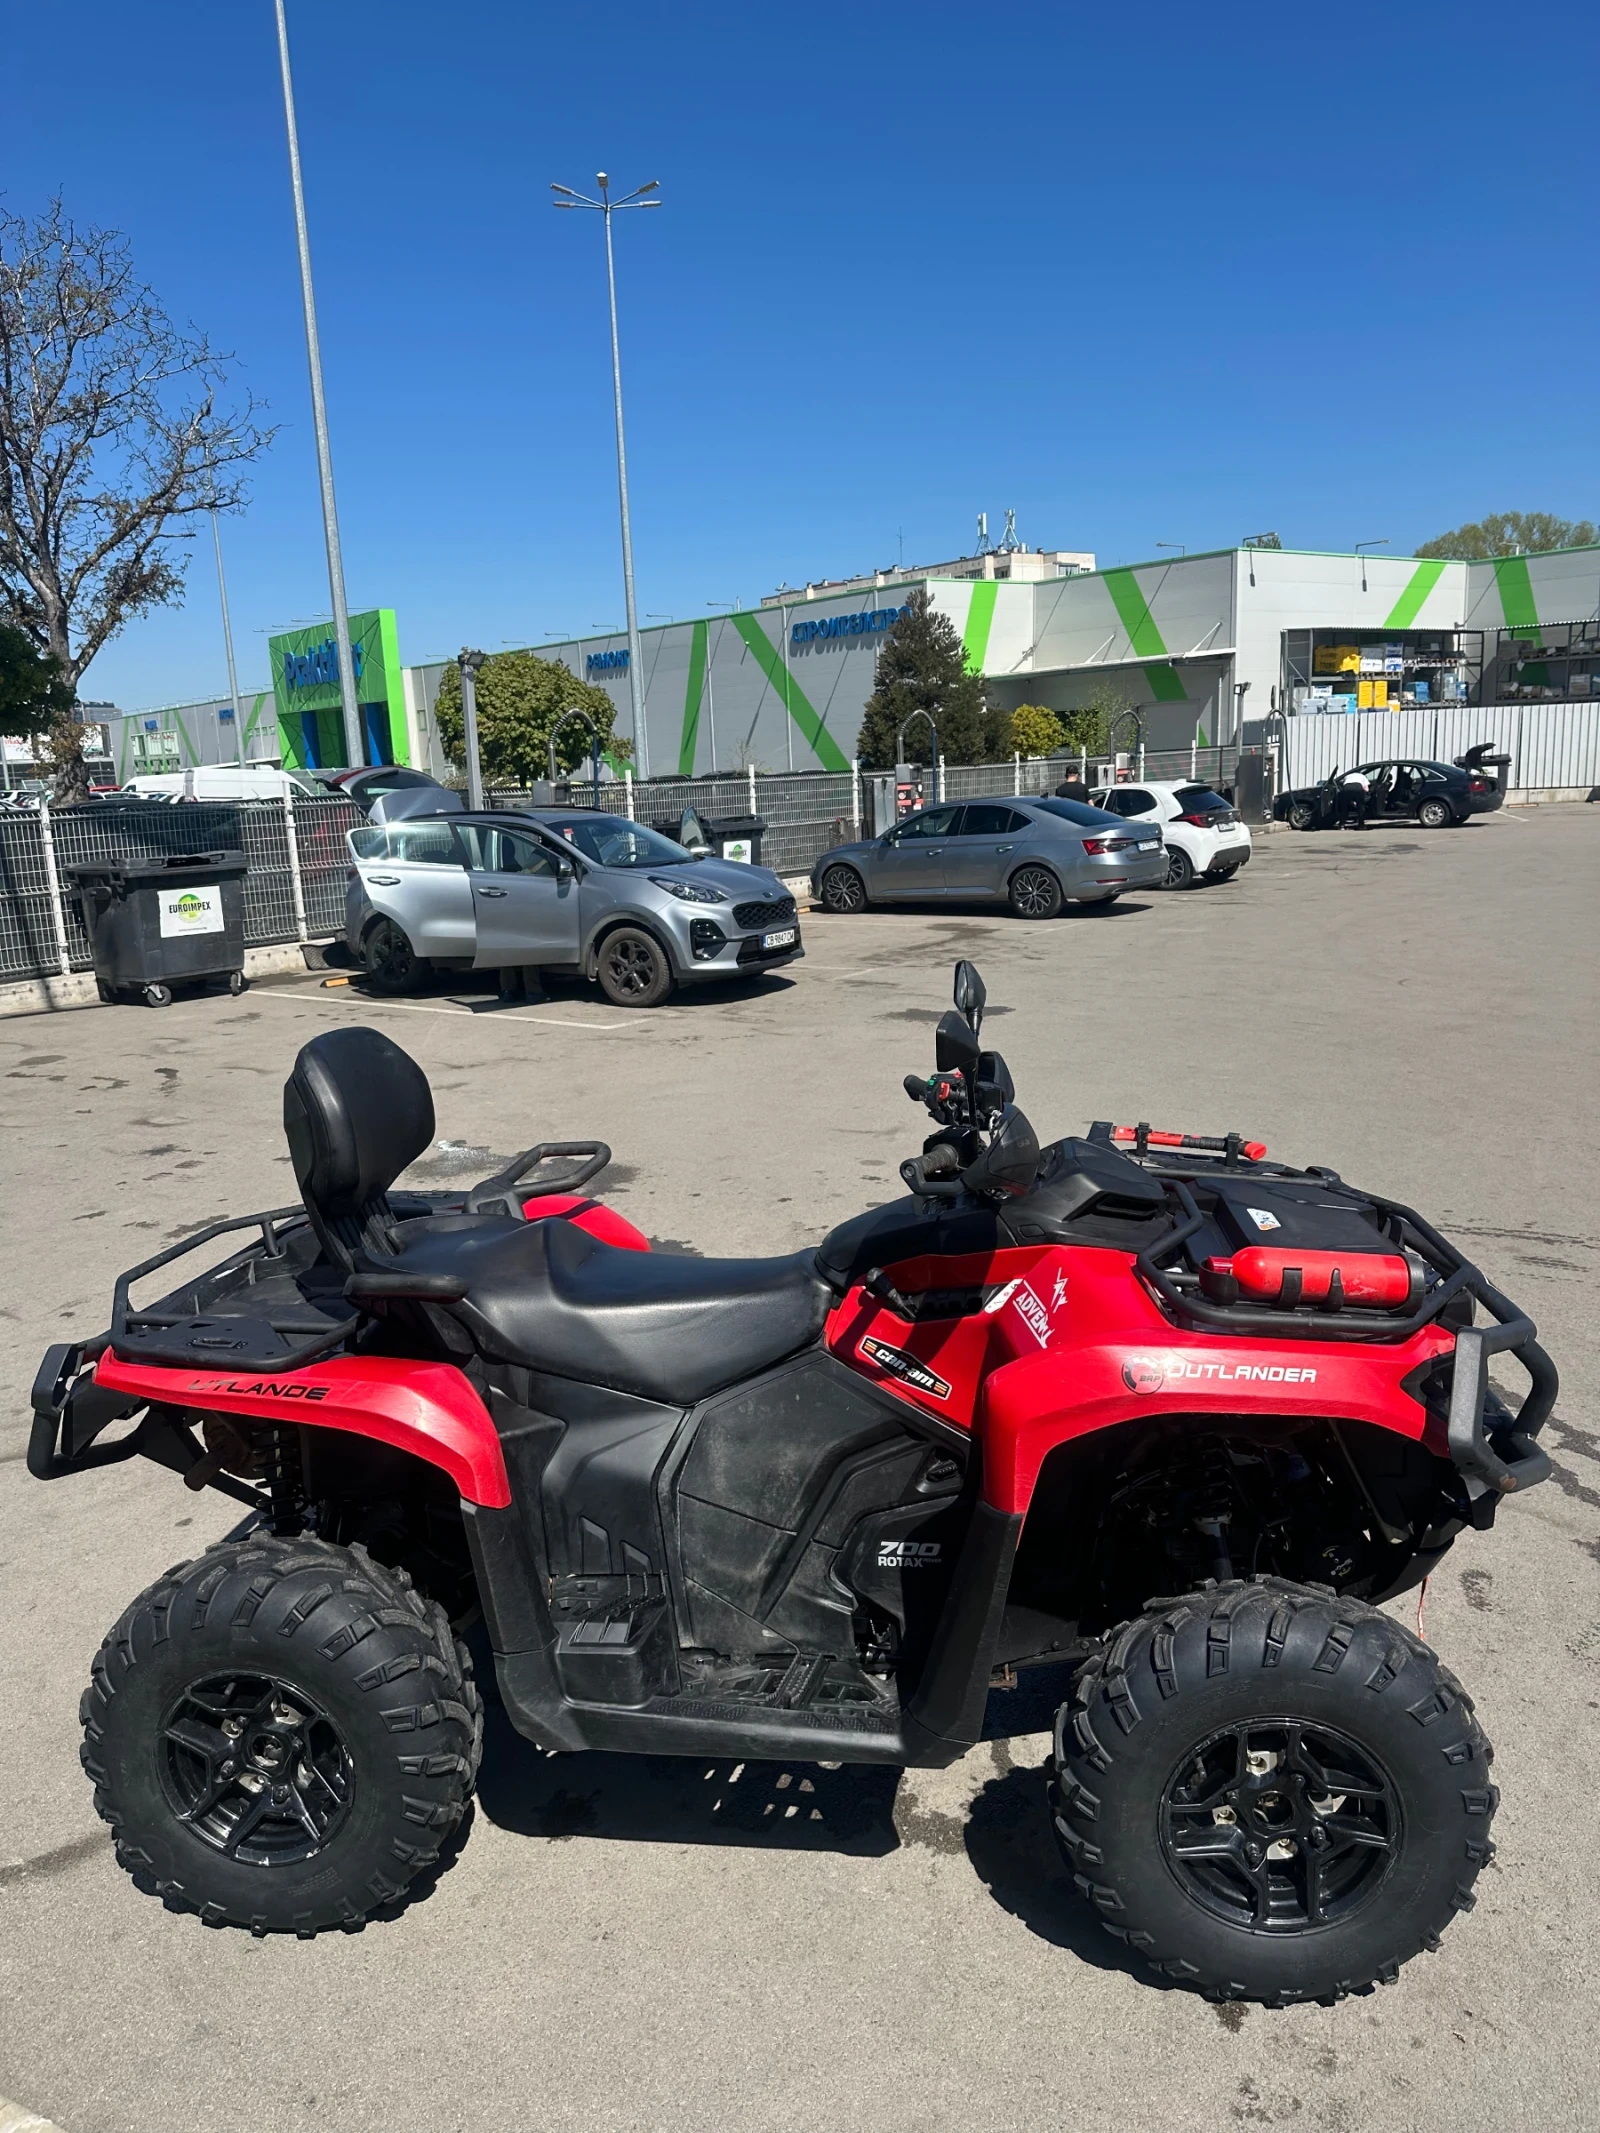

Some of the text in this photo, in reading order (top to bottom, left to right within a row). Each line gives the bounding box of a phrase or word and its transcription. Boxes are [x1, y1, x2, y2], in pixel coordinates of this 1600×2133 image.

[168, 901, 211, 914] EUROIMPEX
[1139, 1374, 1161, 1383] BRP
[1165, 1363, 1317, 1384] OUTLANDER
[878, 1540, 942, 1556] 700
[877, 1556, 923, 1568] ROTAX
